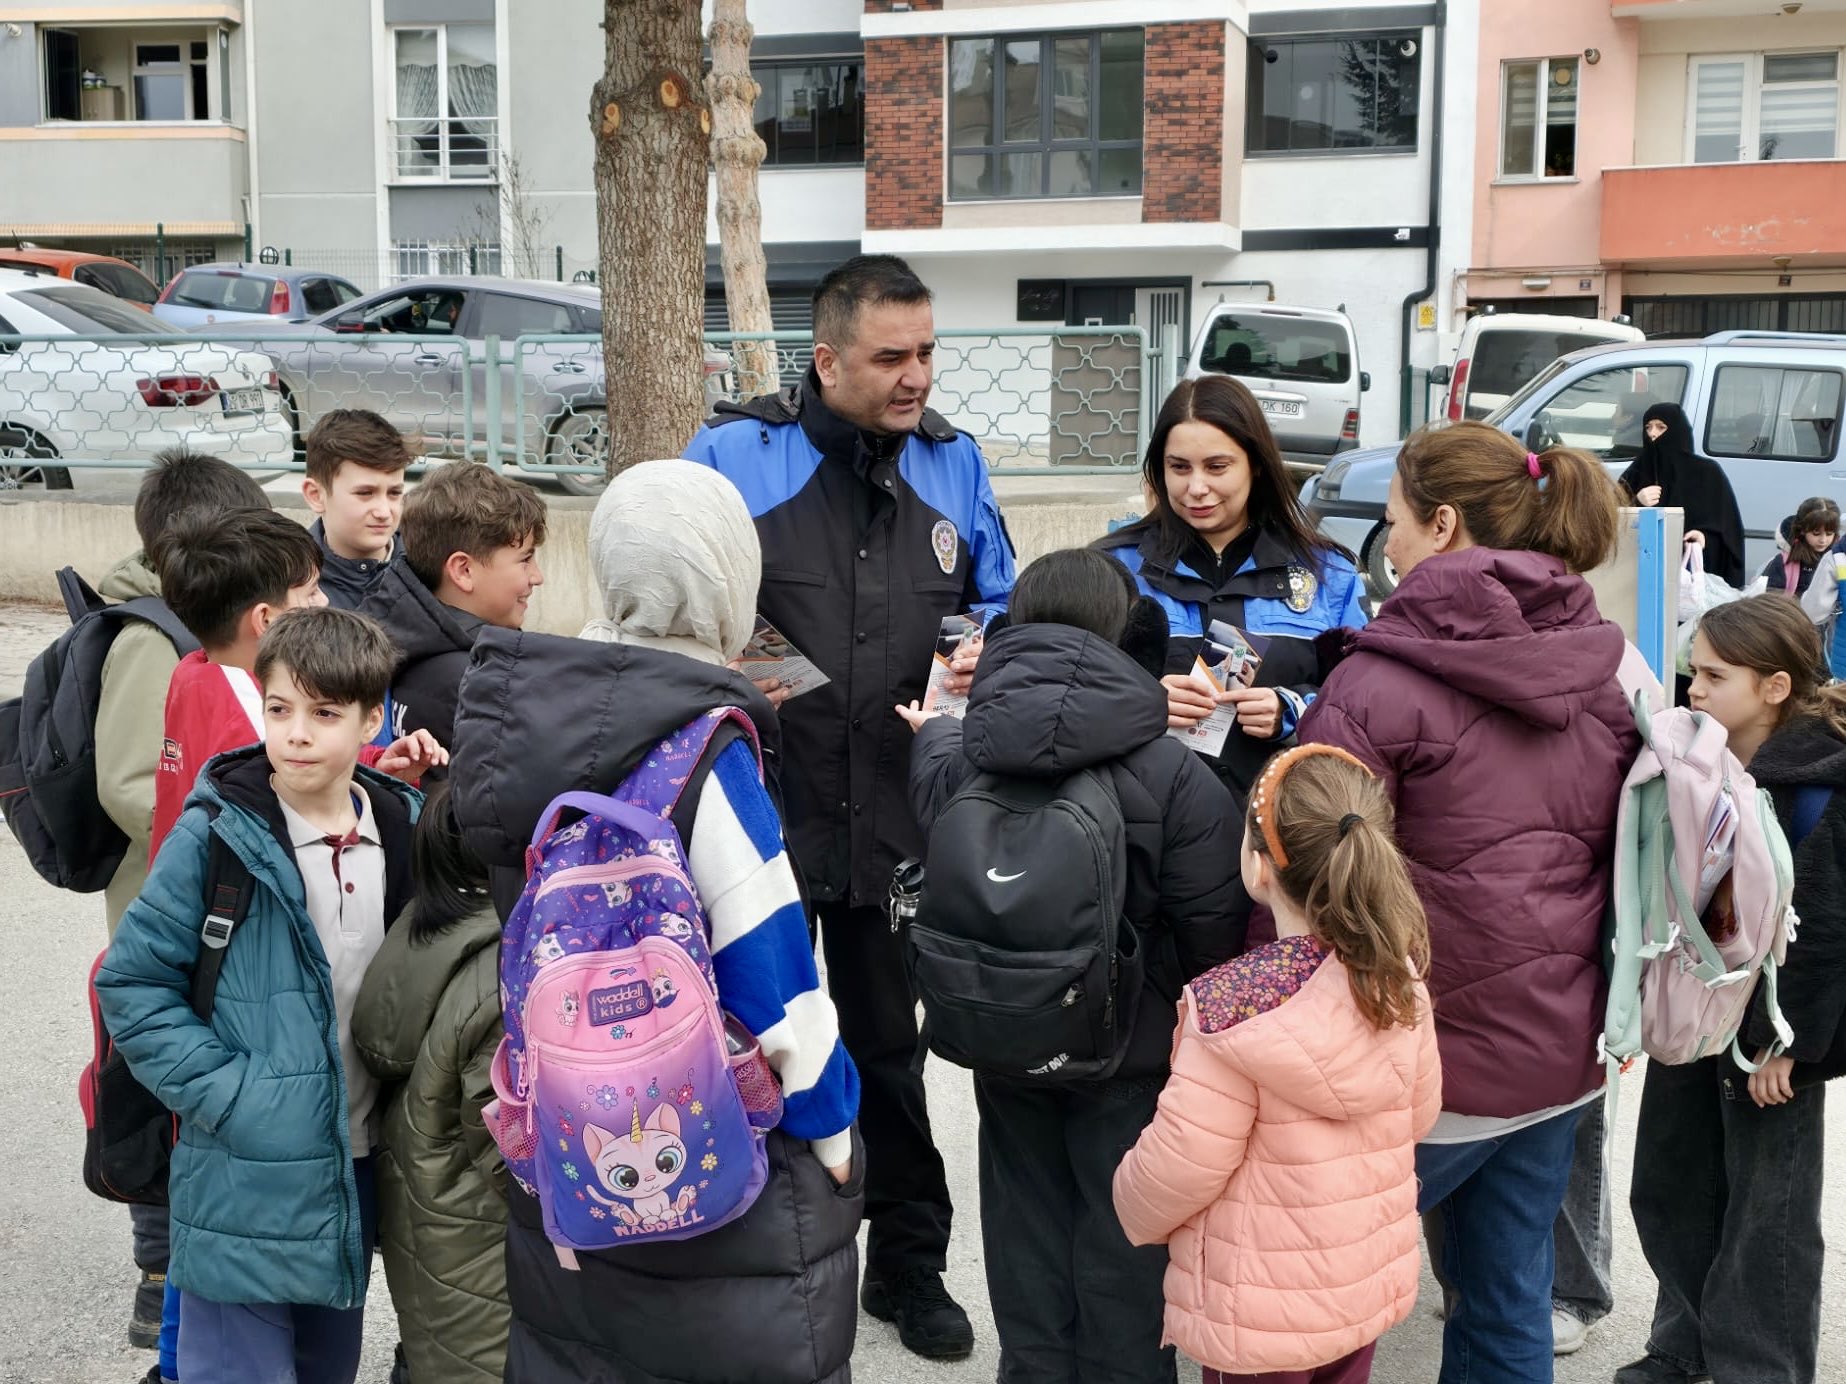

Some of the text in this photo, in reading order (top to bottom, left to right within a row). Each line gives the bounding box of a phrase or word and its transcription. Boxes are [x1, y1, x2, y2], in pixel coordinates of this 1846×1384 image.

[1281, 402, 1298, 413] 160
[600, 1003, 633, 1018] kids
[1048, 1056, 1063, 1071] DO
